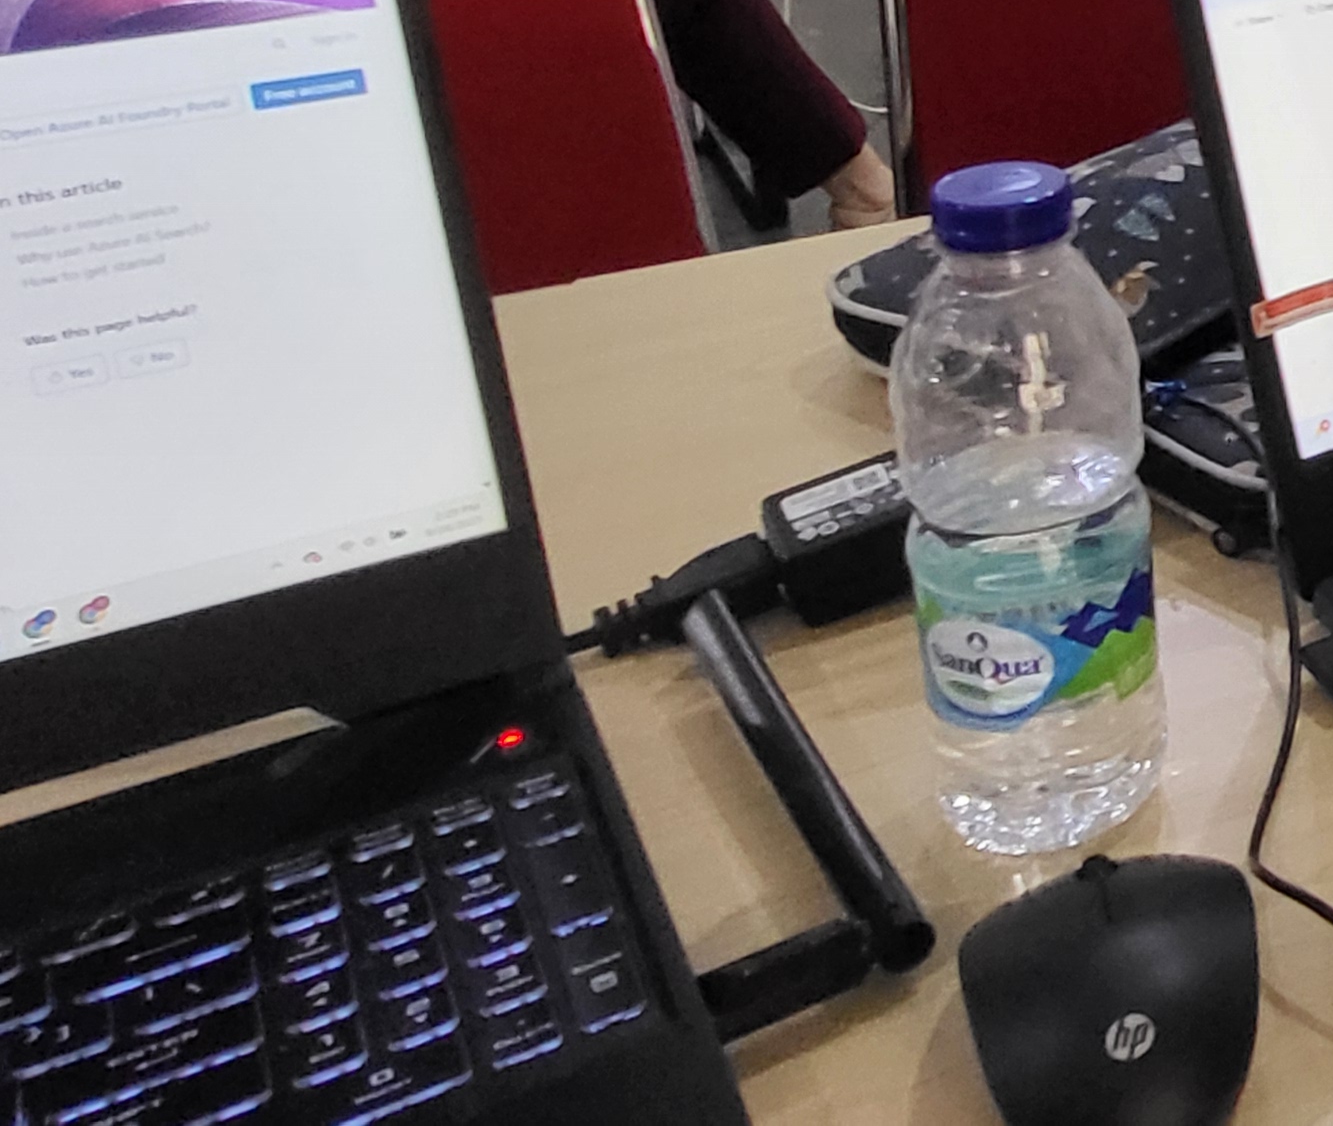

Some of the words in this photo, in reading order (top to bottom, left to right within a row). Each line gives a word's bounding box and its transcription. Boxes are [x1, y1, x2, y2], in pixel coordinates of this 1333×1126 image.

[16, 190, 56, 206] this
[60, 178, 123, 199] article
[1110, 1016, 1152, 1061] hp
